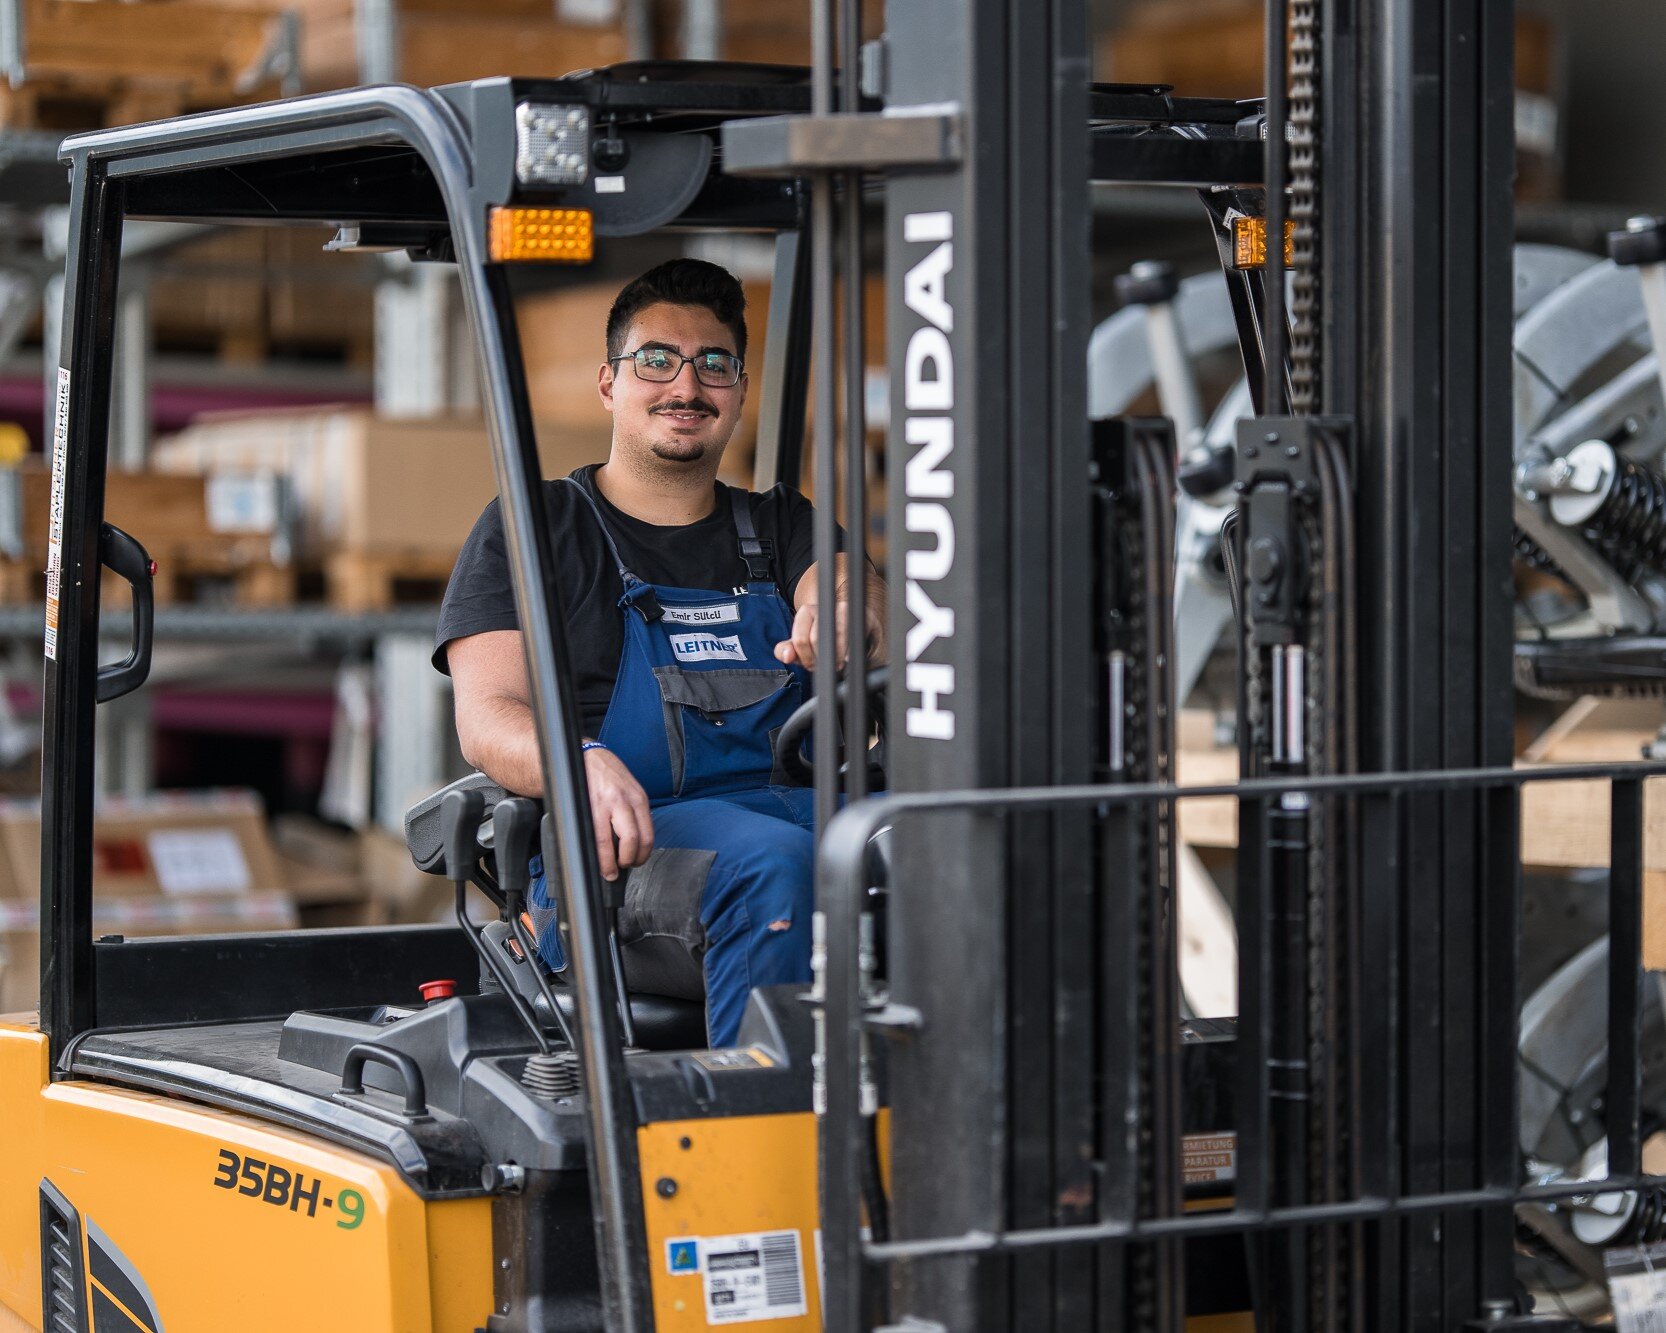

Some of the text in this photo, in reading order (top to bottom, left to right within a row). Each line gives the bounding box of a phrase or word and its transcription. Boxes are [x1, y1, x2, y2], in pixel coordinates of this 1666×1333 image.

[53, 384, 67, 539] STAPLERTECHNIK
[904, 211, 955, 741] HYUNDAI
[671, 611, 691, 621] Emir
[675, 639, 737, 654] LEITNER
[213, 1148, 366, 1231] 35BH-9
